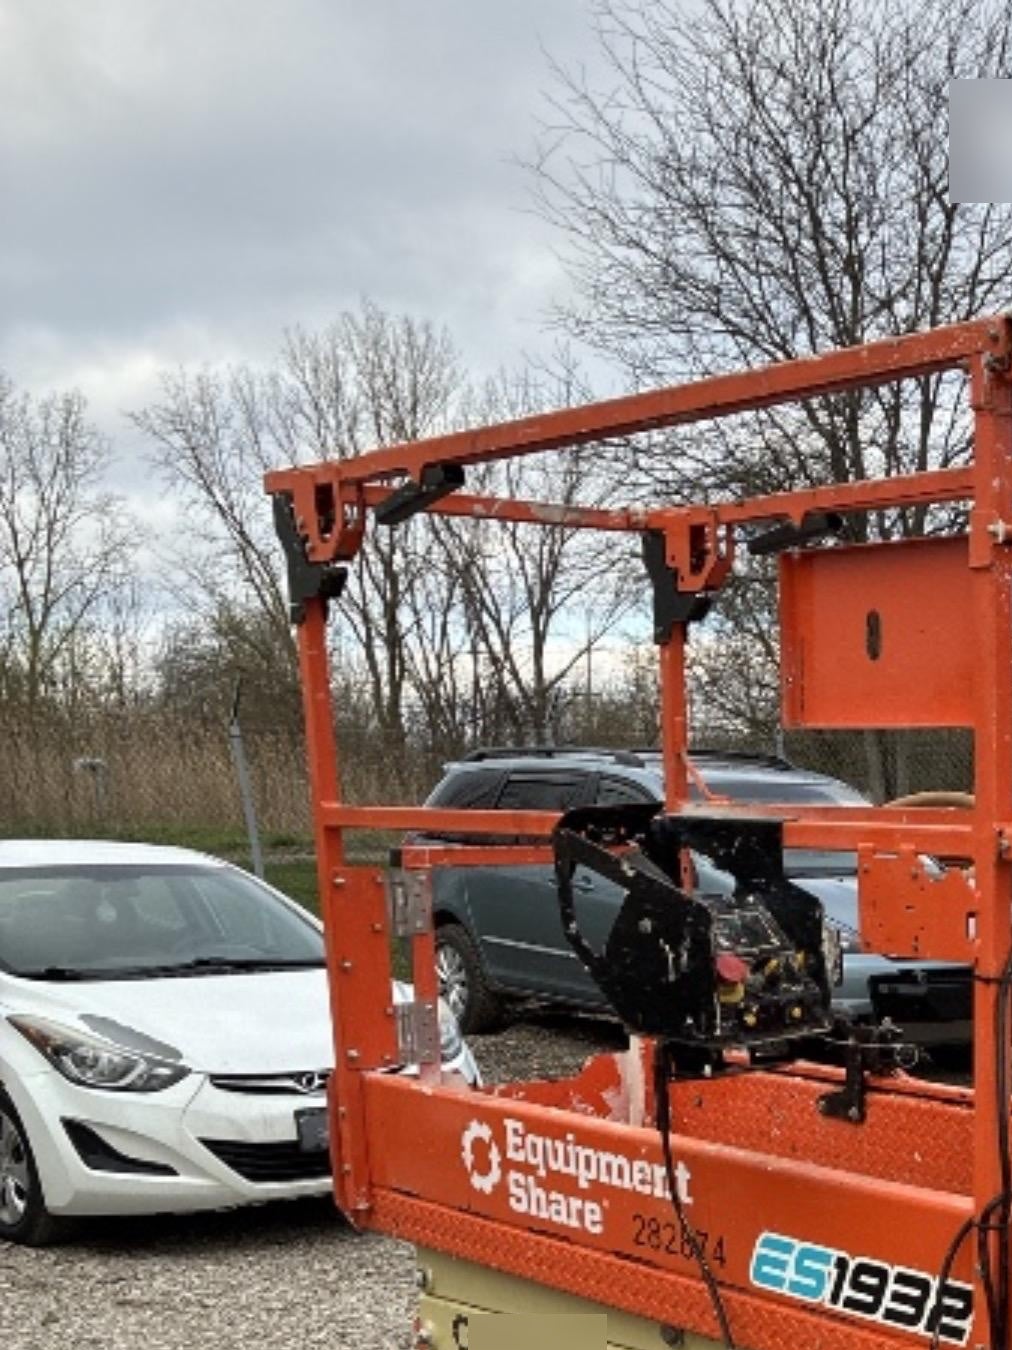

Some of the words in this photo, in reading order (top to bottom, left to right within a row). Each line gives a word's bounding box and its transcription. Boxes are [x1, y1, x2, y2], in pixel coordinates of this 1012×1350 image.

[503, 1118, 693, 1204] Equipment
[507, 1169, 603, 1235] Share
[751, 1232, 975, 1346] ES1932
